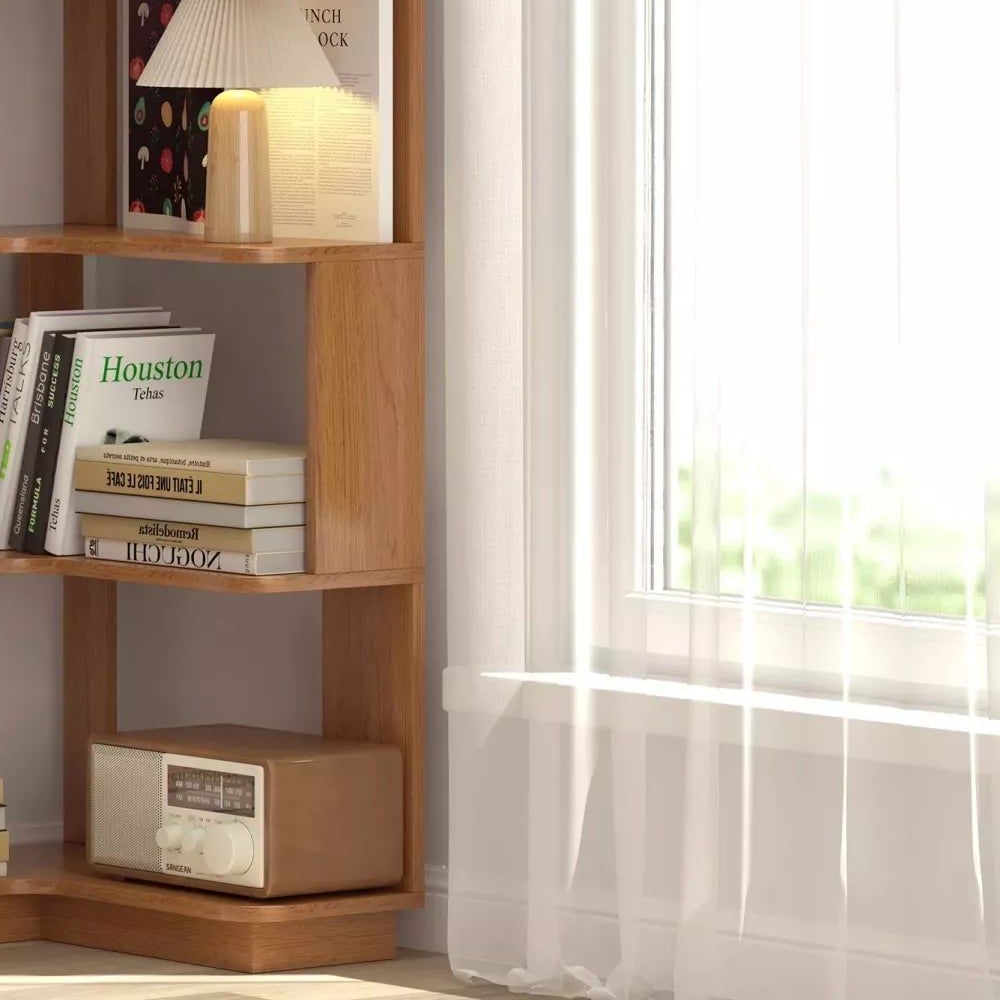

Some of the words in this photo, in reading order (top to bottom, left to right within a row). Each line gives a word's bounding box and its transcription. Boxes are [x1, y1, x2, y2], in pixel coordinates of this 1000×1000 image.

[100, 356, 203, 383] Houston
[132, 386, 164, 400] Tehas
[14, 475, 29, 535] Queensland
[30, 351, 51, 425] Brisbane
[28, 477, 42, 533] FORMULA
[40, 428, 49, 454] FOR
[47, 354, 61, 408] SUCCESS
[49, 498, 61, 531] Tehas
[64, 358, 83, 427] Houston
[166, 863, 192, 874] SANGEAN
